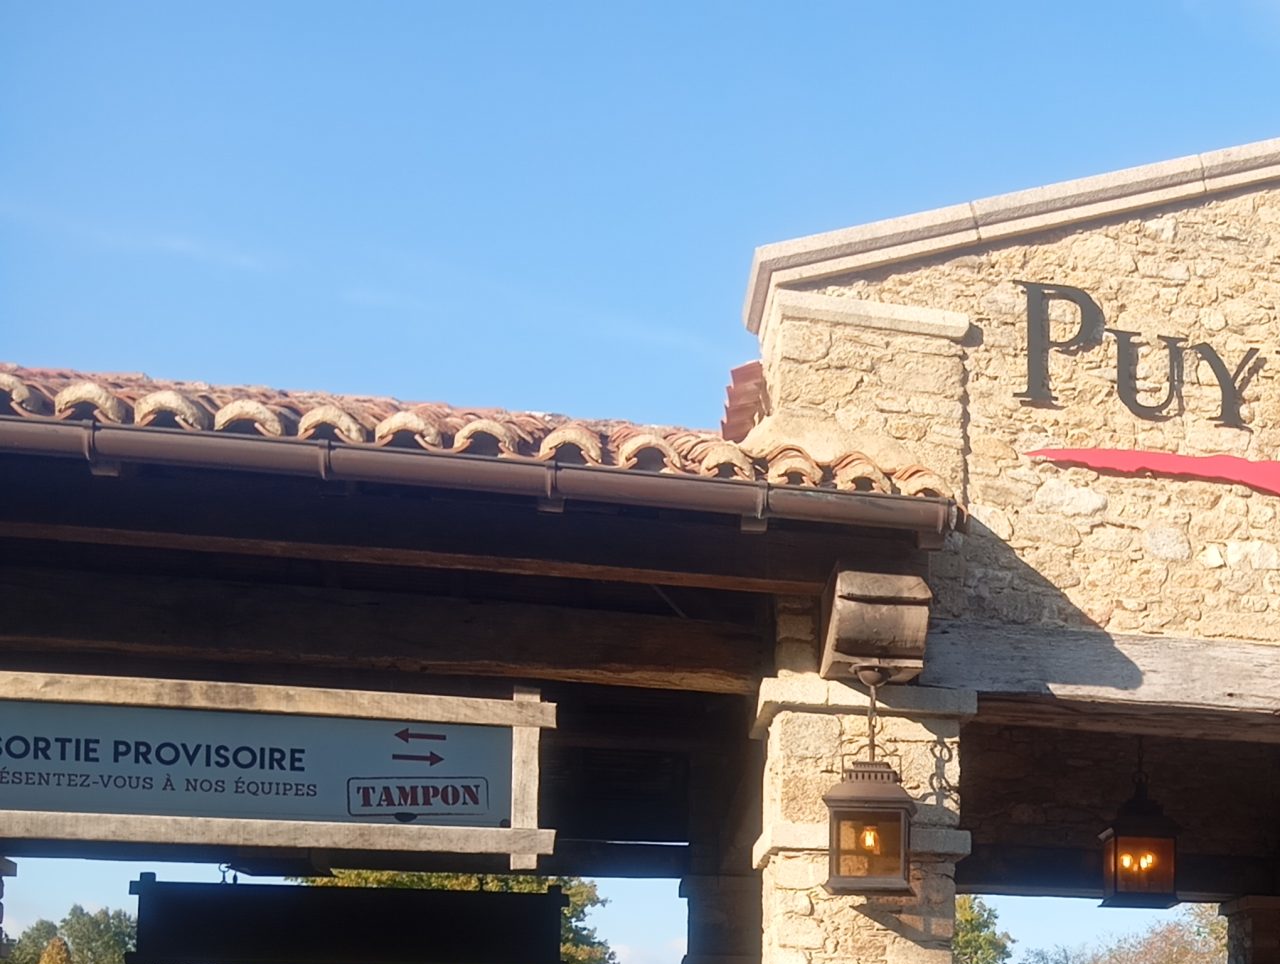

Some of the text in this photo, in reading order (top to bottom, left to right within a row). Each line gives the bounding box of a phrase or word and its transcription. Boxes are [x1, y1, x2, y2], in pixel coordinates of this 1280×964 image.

[0, 735, 306, 772] ORTIE PROVISOIRE
[162, 773, 176, 791] À
[185, 778, 226, 793] NOS
[233, 776, 317, 797] ÉQUIPES
[356, 784, 481, 807] TAMPON
